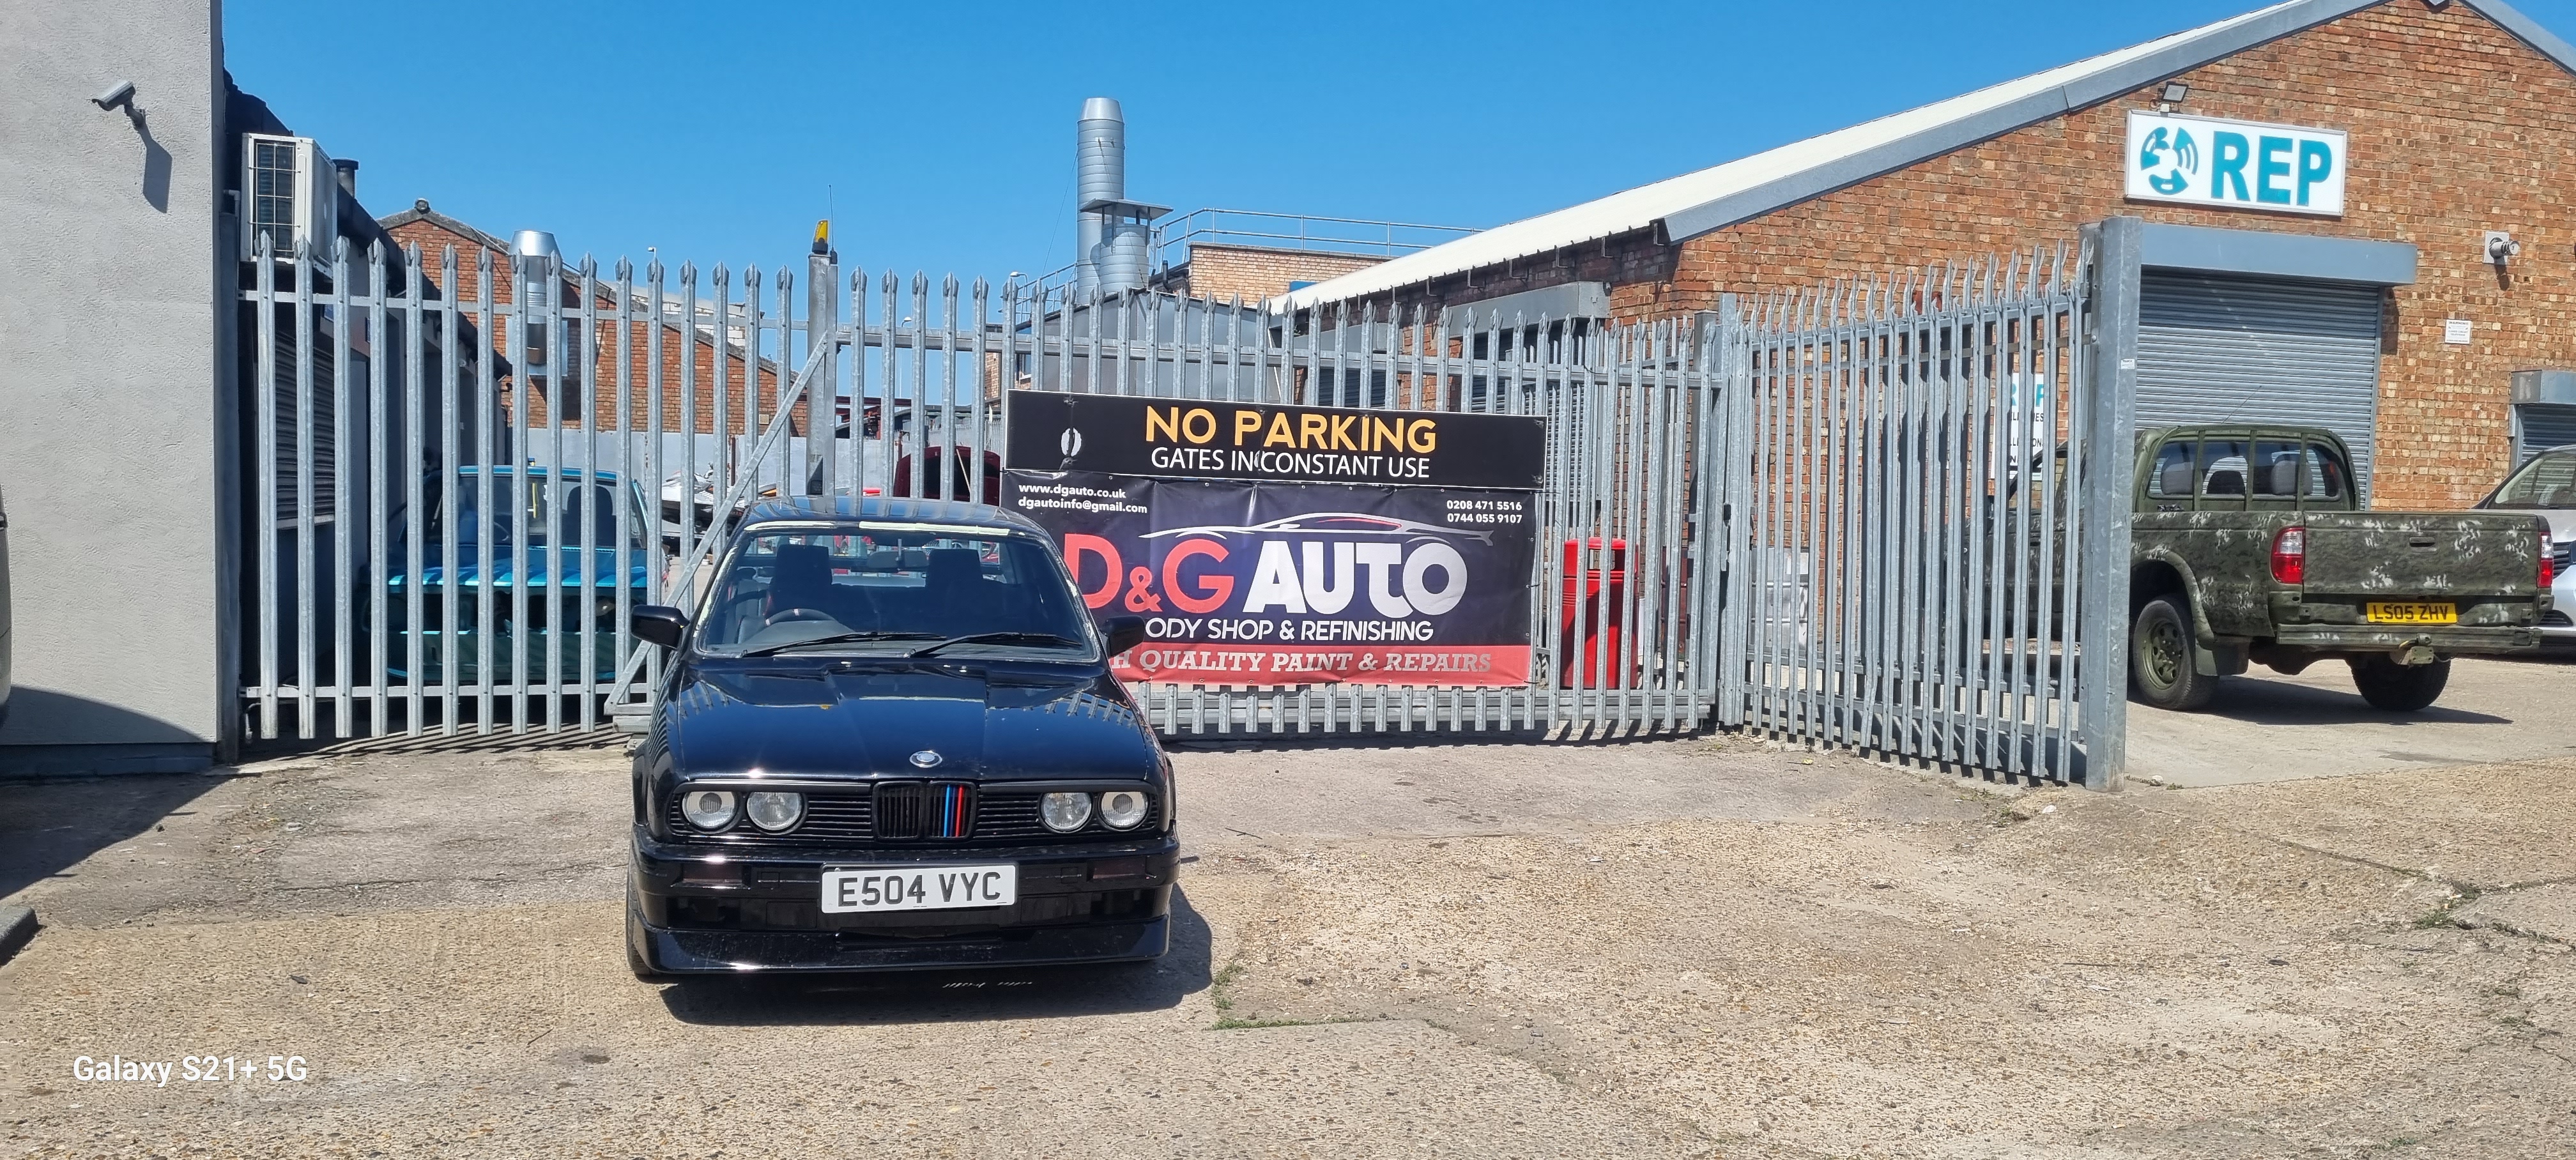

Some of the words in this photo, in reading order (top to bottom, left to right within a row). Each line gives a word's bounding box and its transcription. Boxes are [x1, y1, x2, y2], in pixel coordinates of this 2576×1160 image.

[2211, 130, 2333, 207] REP
[1146, 405, 1216, 444] NO
[1234, 409, 1437, 454] PARKING
[1151, 446, 1224, 471] GATES
[1231, 450, 1254, 472] IN
[1260, 451, 1383, 476] CONSTANT
[1388, 457, 1430, 478] USE
[1018, 484, 1126, 499] www.dgauto.co.uk
[1018, 496, 1147, 514] dgautoinfo@gmail.com
[1446, 500, 1473, 510] 0208
[1475, 500, 1494, 510] 471
[1497, 501, 1522, 511] 5516
[1447, 513, 1473, 523] 0744
[1476, 514, 1495, 523] 055
[1497, 514, 1522, 523] 9107
[1064, 533, 1234, 614] D&G
[1242, 540, 1468, 618] AUTO
[2373, 604, 2414, 620] LS05
[2418, 605, 2448, 620] ZHV
[1145, 618, 1204, 639] ODY
[1208, 618, 1274, 640] SHOP
[1279, 619, 1295, 641] &
[1300, 620, 1434, 642] REFINISHING
[1140, 650, 1266, 673] QUALITY
[1271, 652, 1353, 673] PAINT
[1358, 653, 1379, 671] &
[1383, 653, 1492, 673] REPAIRS
[838, 874, 926, 907] E504
[938, 871, 1001, 903] VYC
